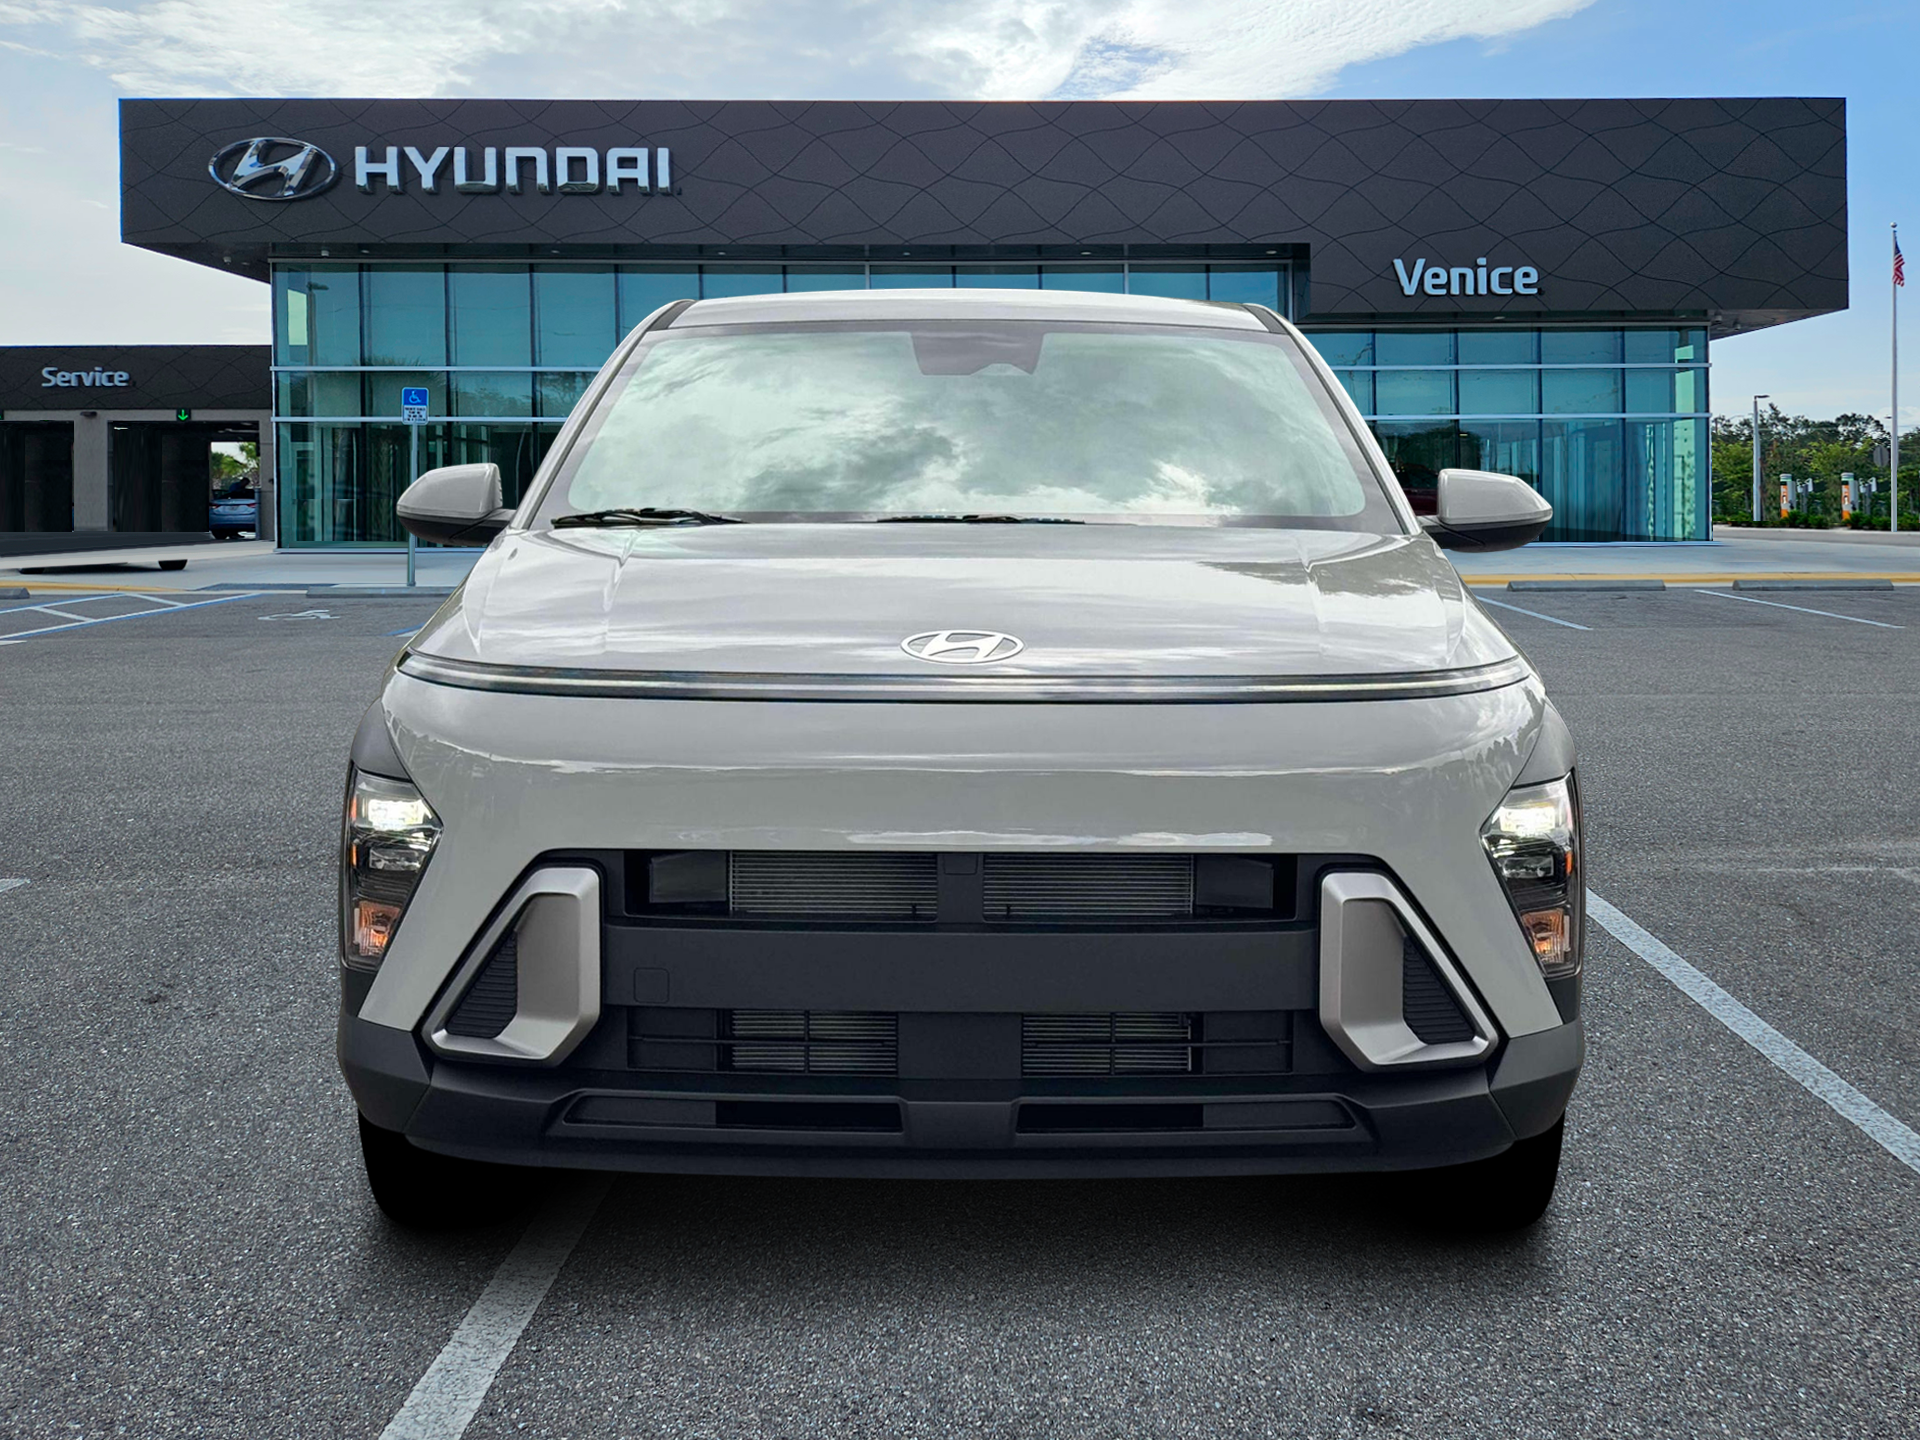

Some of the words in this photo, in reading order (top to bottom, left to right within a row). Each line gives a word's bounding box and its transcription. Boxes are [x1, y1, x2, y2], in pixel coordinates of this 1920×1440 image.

[354, 146, 673, 194] HYUNDAI
[1392, 256, 1539, 296] Venice
[41, 366, 130, 387] Service
